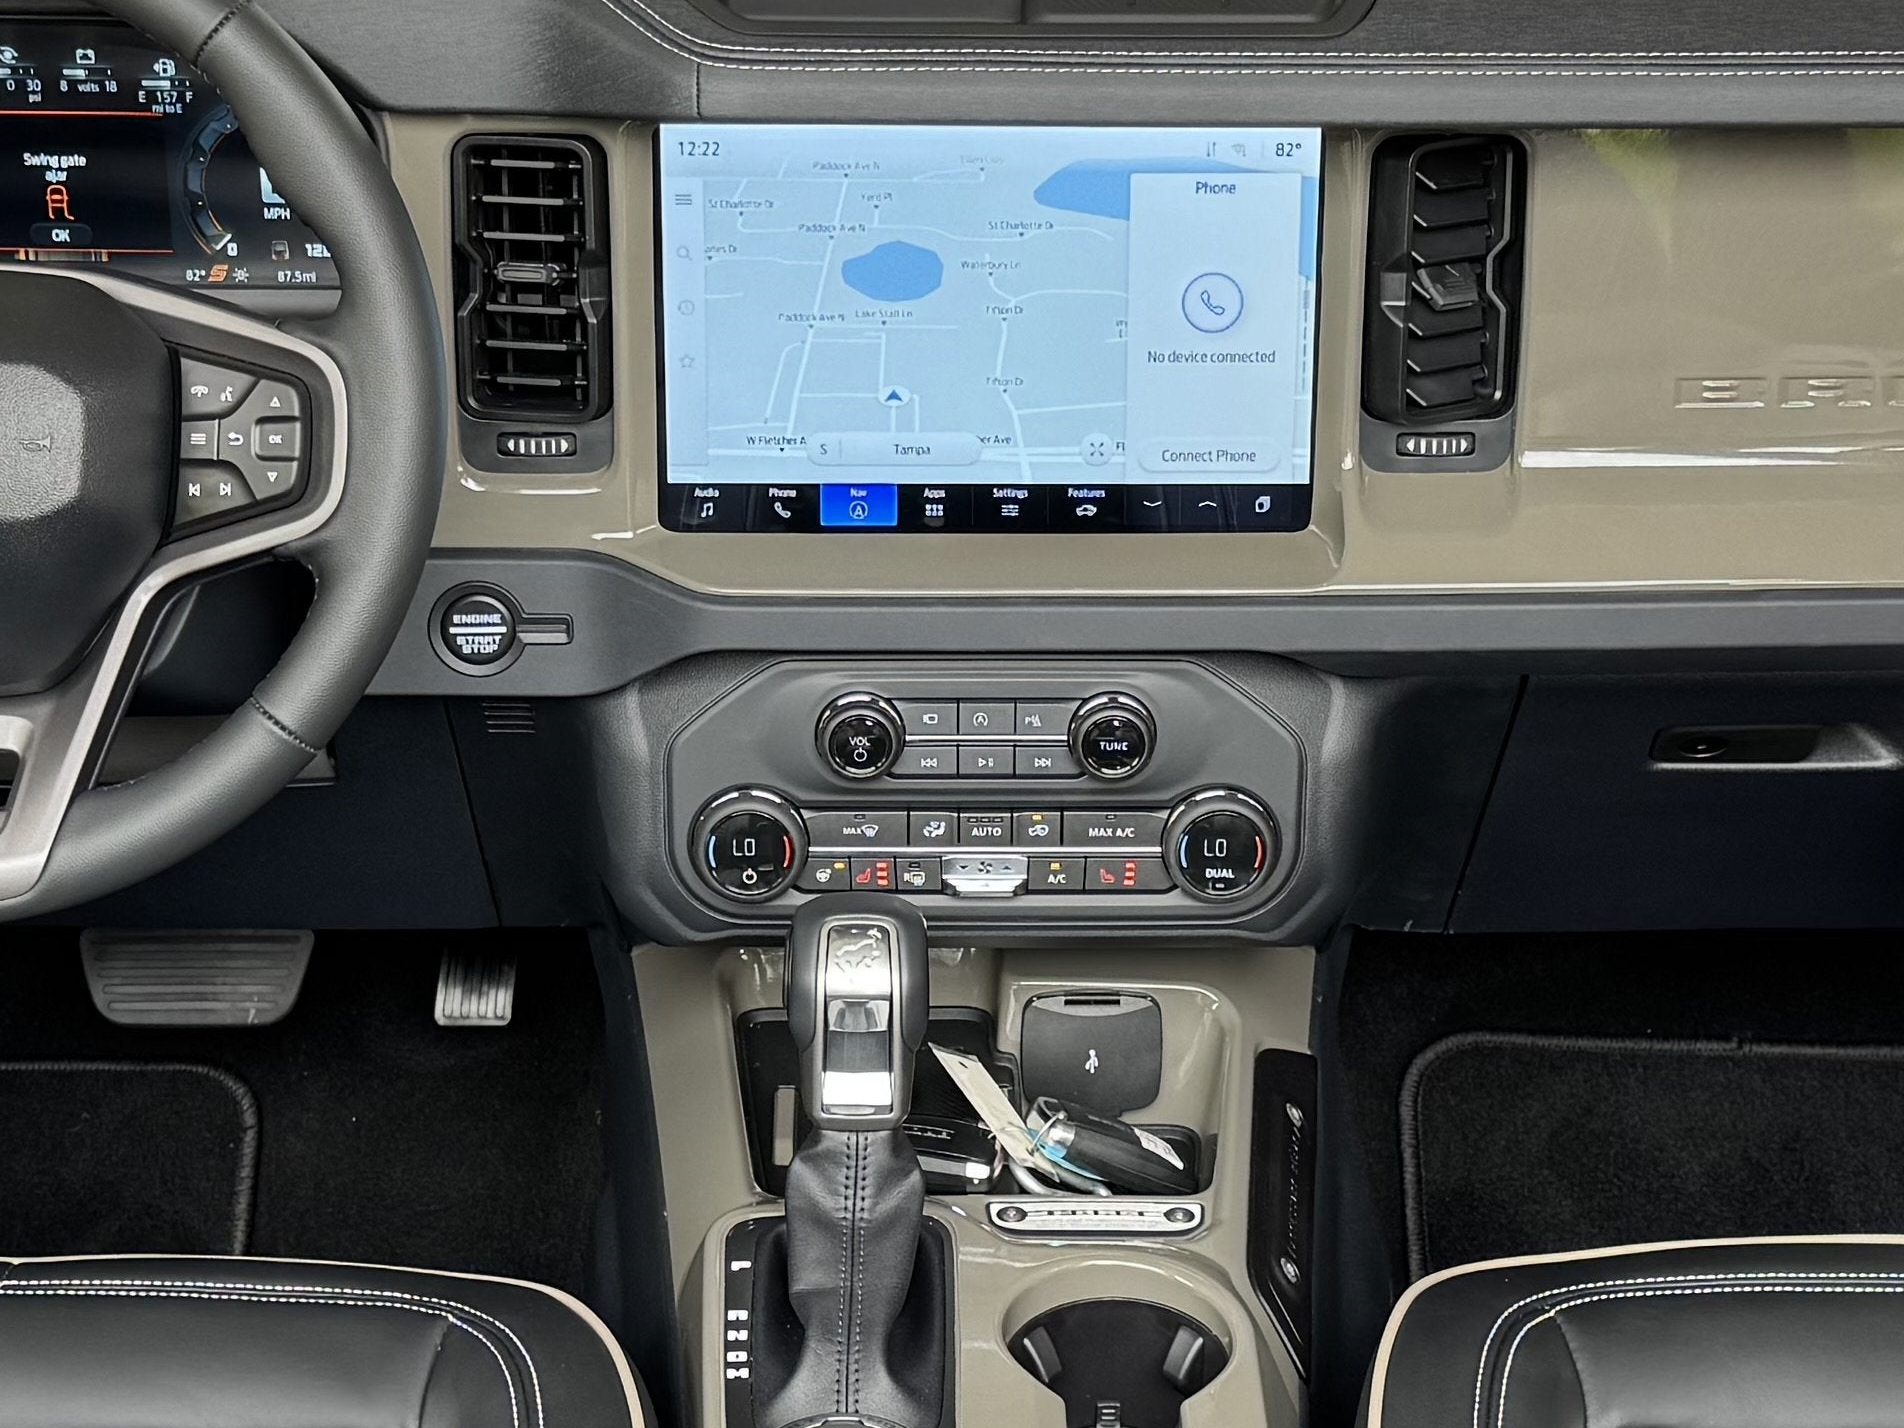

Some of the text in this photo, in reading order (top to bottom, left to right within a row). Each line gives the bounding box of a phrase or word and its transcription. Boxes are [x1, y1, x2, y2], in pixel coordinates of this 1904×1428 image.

[6, 79, 15, 91] 0
[26, 79, 42, 92] 30
[59, 80, 117, 93] 8 volts 18
[28, 92, 42, 103] psi
[138, 91, 193, 103] E 157 F
[152, 104, 183, 114] mi to E
[678, 141, 720, 156] 12:22
[1275, 142, 1302, 157] 82°
[23, 152, 86, 168] Swing gate
[45, 169, 68, 184] ajar
[1195, 181, 1236, 194] Phone
[263, 207, 291, 220] MPH
[1000, 221, 1043, 230] Charlotte
[51, 228, 70, 242] OK
[226, 243, 238, 256] 0
[961, 260, 1008, 270] Waterbury
[1147, 350, 1276, 363] No device connected
[268, 434, 283, 444] OK
[746, 436, 798, 446] W Fletcher
[993, 435, 1012, 445] Ave
[819, 444, 828, 455] S
[893, 444, 931, 456] Tampa
[1161, 449, 1256, 462] Connect Phone
[694, 488, 719, 498] Audio
[768, 488, 796, 498] Phone
[850, 488, 868, 498] Nav
[923, 488, 946, 500] Apps
[992, 487, 1028, 500] Settings
[1068, 487, 1106, 498] Features
[452, 613, 502, 624] ENGINE
[456, 635, 502, 645] START
[462, 644, 498, 654] STOP
[849, 736, 871, 747] VOL
[1100, 741, 1128, 752] TUNE
[843, 826, 862, 835] MAX
[971, 827, 1002, 837] AUTO
[1088, 827, 1135, 838] MAX A/C
[1047, 874, 1067, 884] A/C
[1205, 868, 1235, 879] DUAL
[727, 1309, 749, 1321] R
[727, 1329, 748, 1341] N
[726, 1351, 748, 1362] D
[726, 1367, 750, 1379] M
